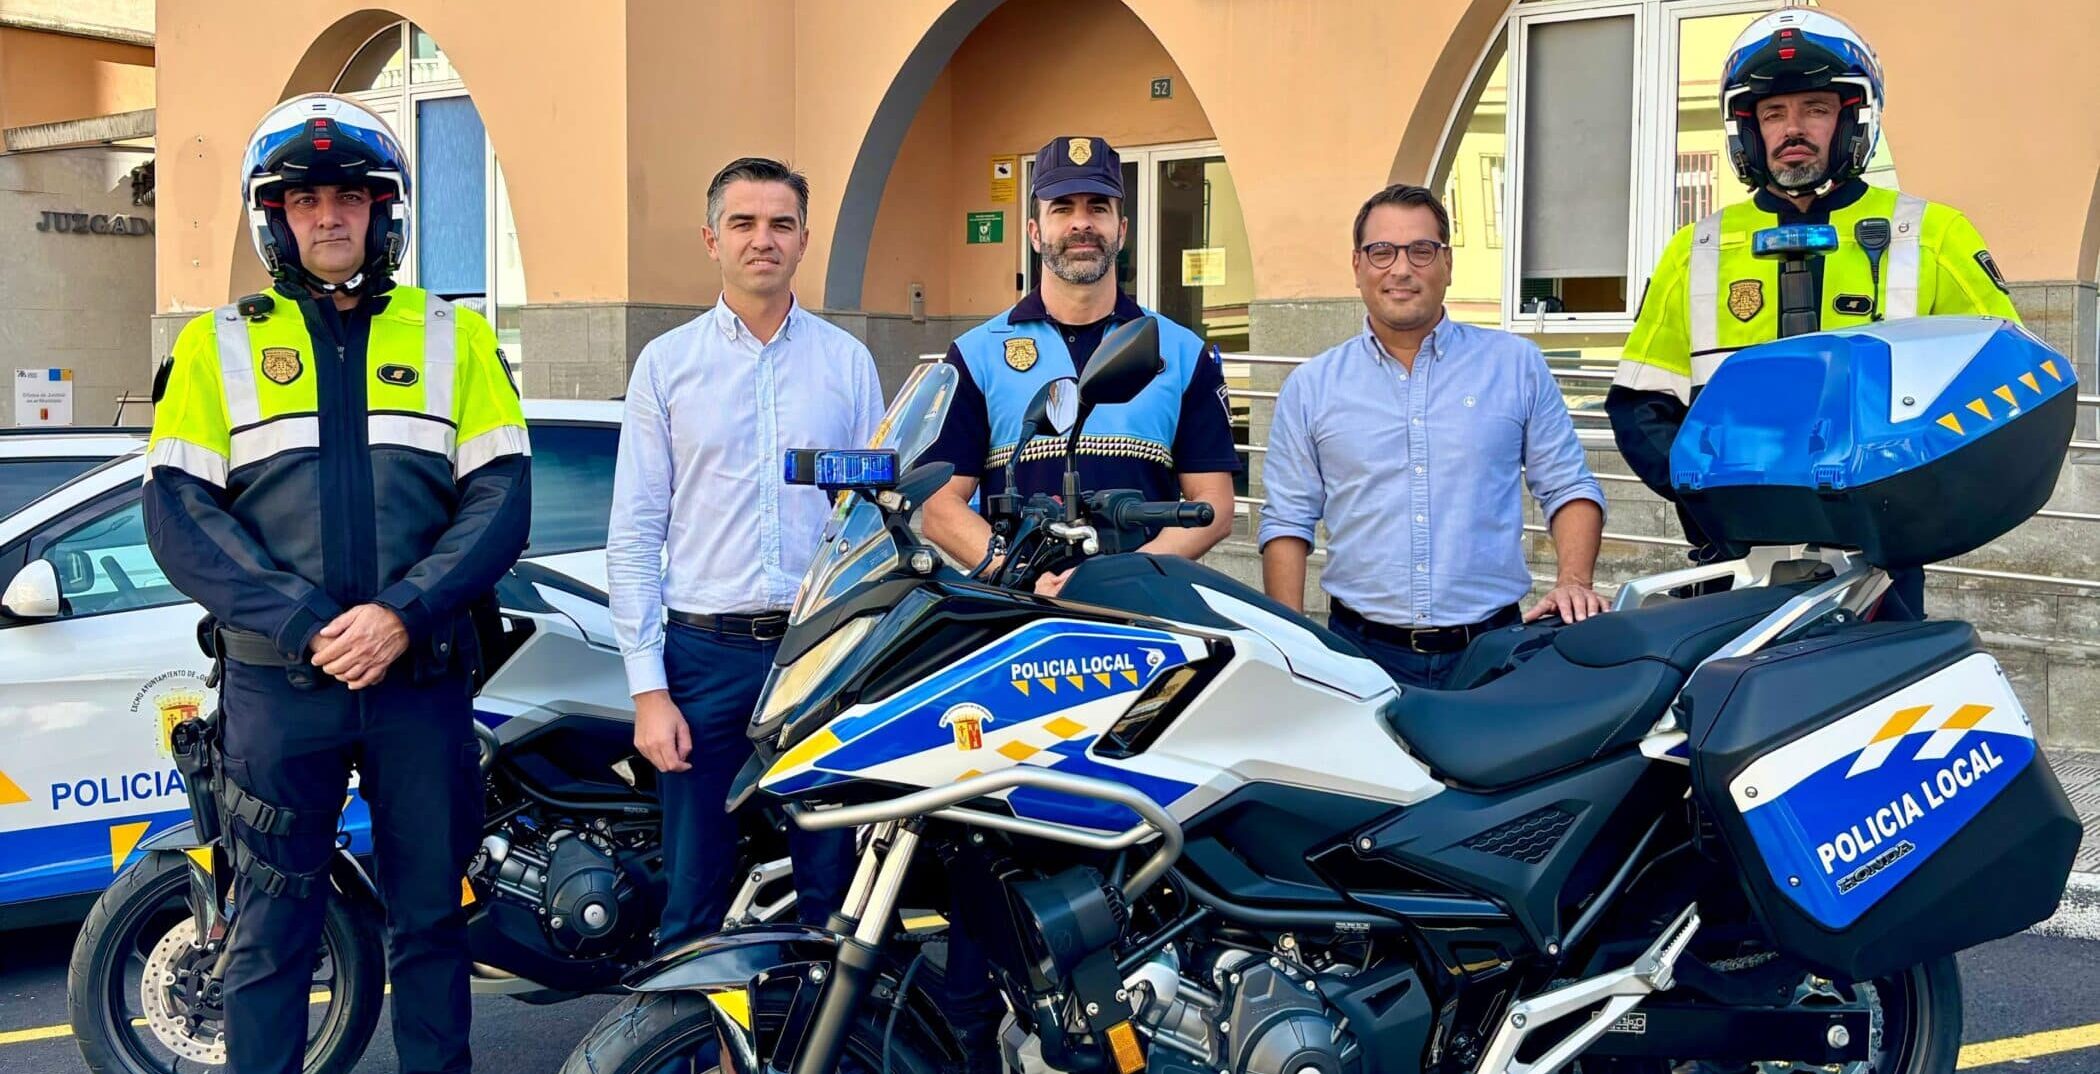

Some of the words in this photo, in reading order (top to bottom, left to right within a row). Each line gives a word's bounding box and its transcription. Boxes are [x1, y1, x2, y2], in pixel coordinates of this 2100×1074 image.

[1154, 82, 1168, 95] 52
[36, 211, 155, 236] JUZGAD
[1010, 658, 1079, 681] POLICIA
[1081, 652, 1135, 674] LOCAL
[51, 769, 187, 810] POLICIA
[1816, 792, 1925, 875] POLICIA
[1920, 741, 2004, 810] LOCAL
[1836, 840, 1916, 895] HONDA
